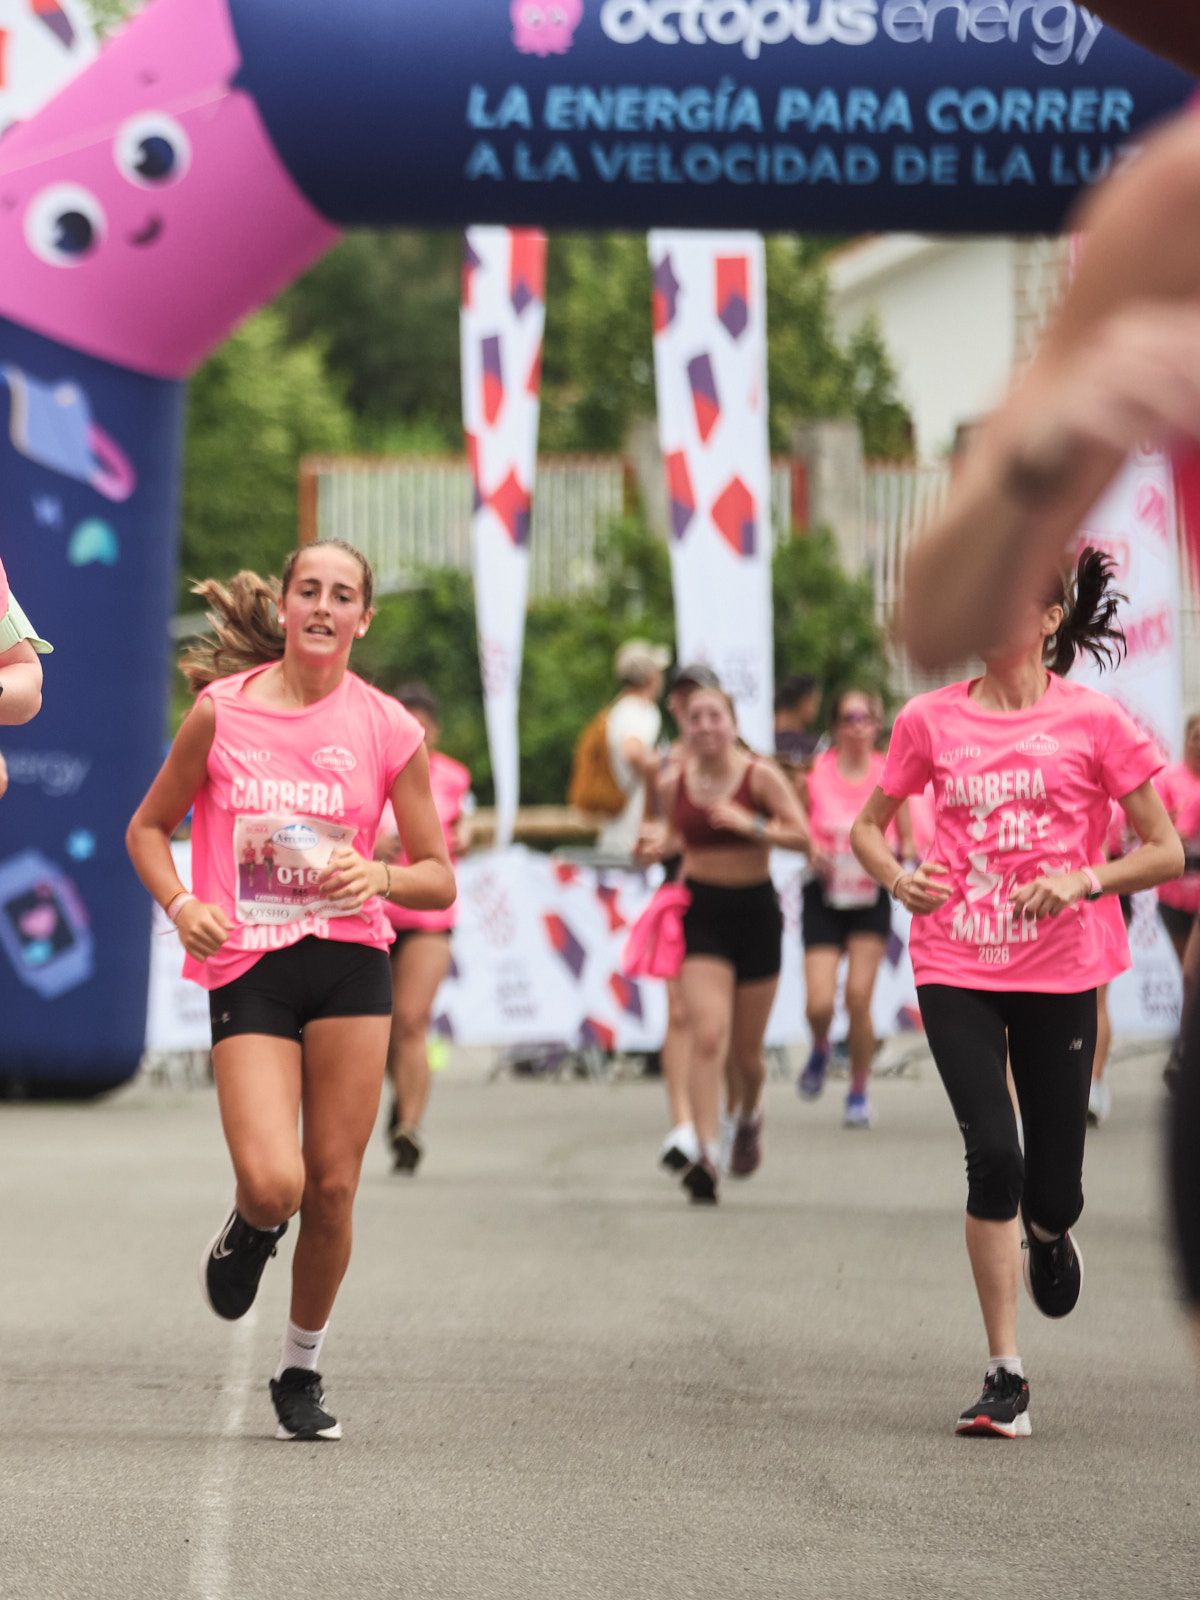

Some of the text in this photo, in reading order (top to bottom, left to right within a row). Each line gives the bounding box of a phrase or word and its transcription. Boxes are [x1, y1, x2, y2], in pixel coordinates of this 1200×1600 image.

[882, 0, 1104, 65] energy
[465, 74, 1135, 134] LA ENERGÍA PARA CORRER
[466, 141, 502, 182] A
[514, 141, 579, 183] LA
[589, 142, 881, 186] VELOCIDAD
[893, 145, 960, 186] DE
[972, 145, 1036, 186] LA
[950, 901, 1038, 946] MUJER
